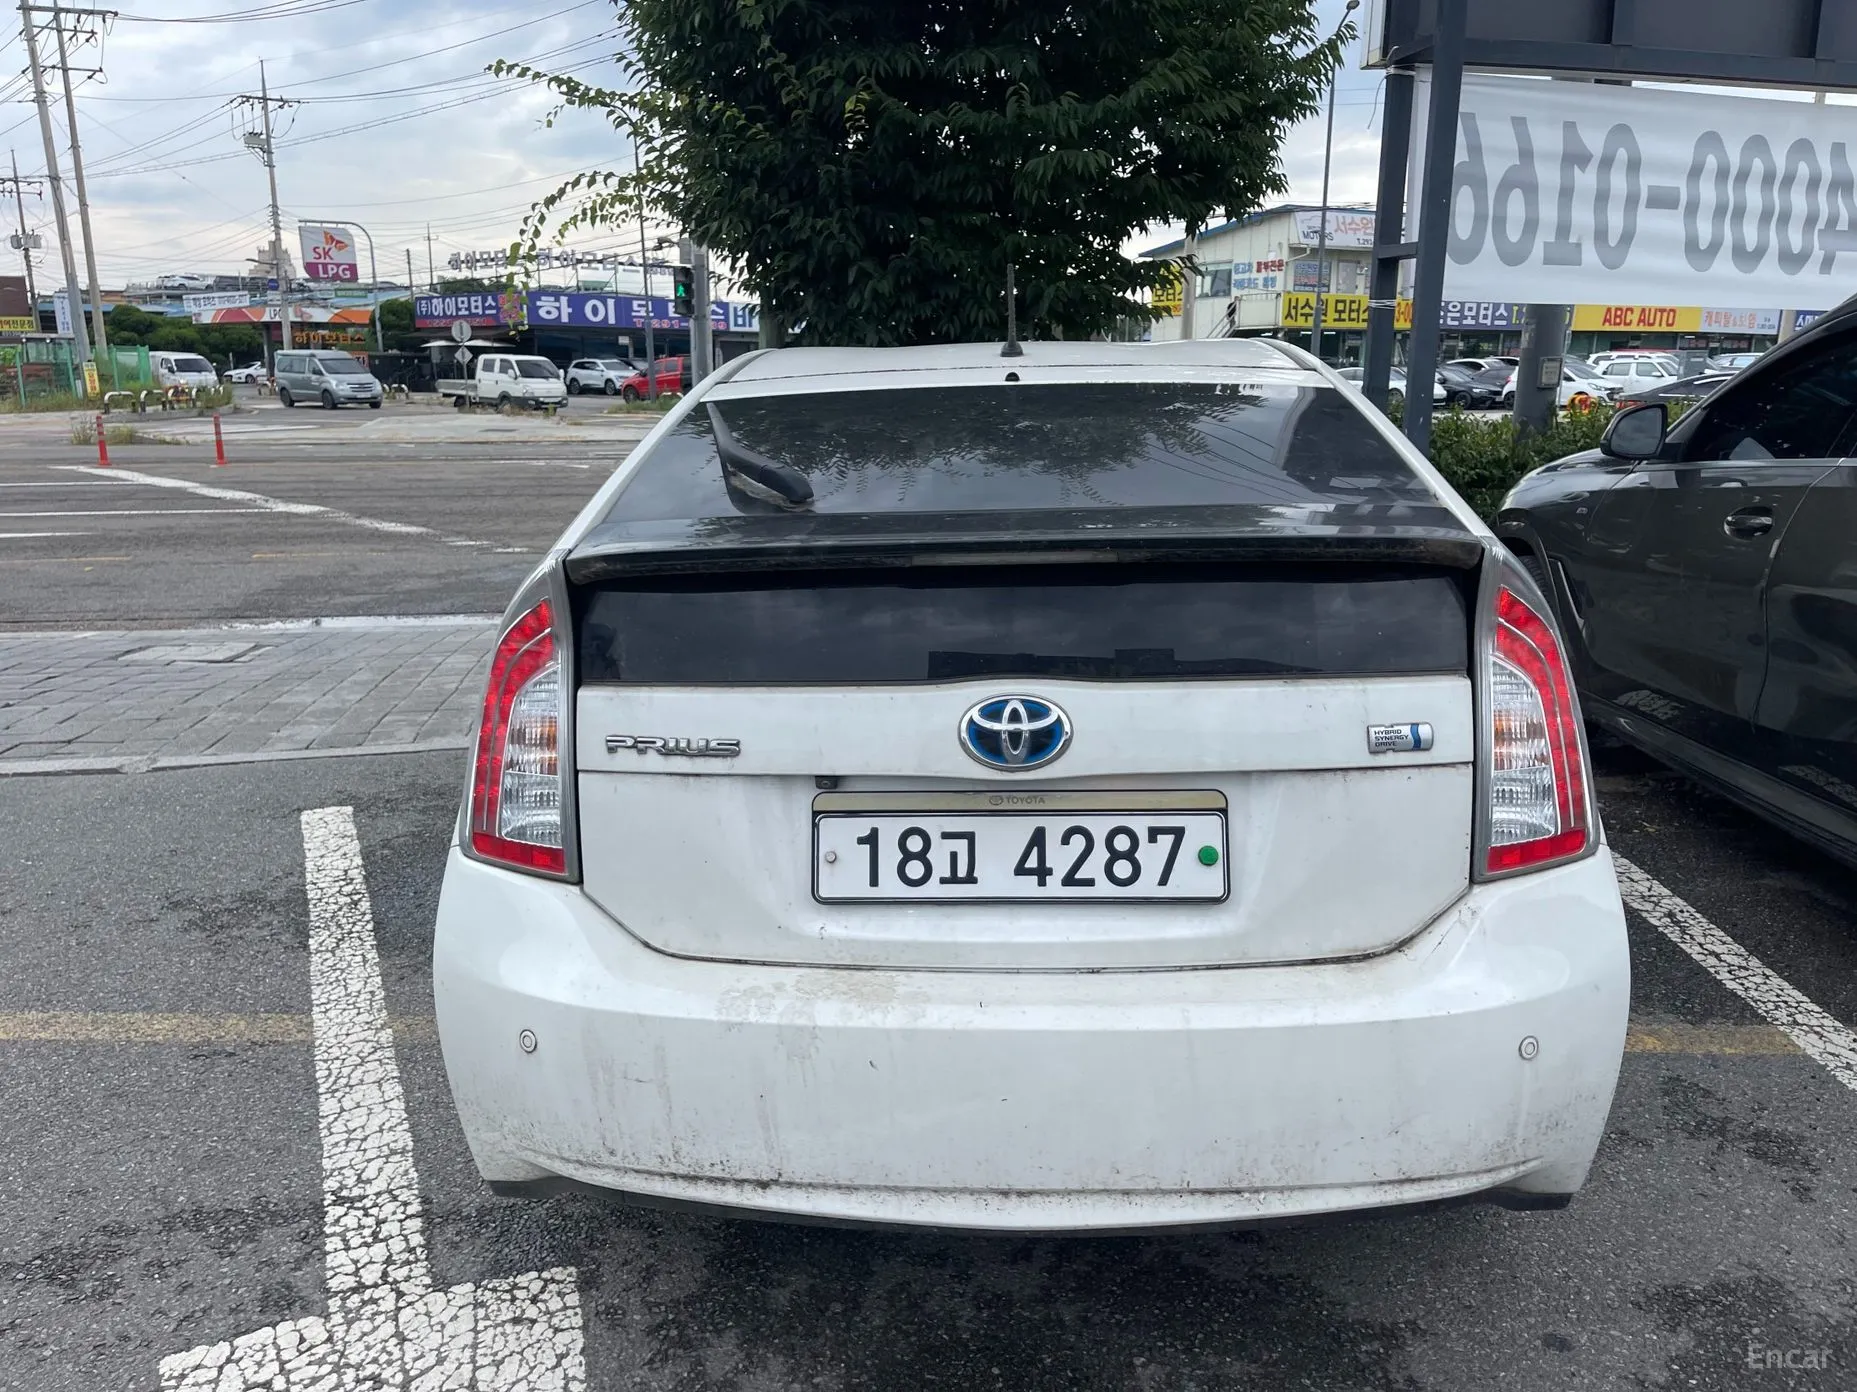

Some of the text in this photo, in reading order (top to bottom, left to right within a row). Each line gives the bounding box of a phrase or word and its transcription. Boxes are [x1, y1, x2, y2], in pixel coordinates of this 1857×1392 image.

[312, 246, 334, 260] SK
[318, 263, 351, 278] LPG
[1602, 306, 1677, 328] ABC AUTO
[1374, 728, 1402, 736] HYBRID
[1374, 734, 1409, 742] SYNERGY
[605, 735, 741, 757] PRIUS
[1005, 795, 1047, 805] TOYOTA
[856, 825, 1187, 888] 18고 4287
